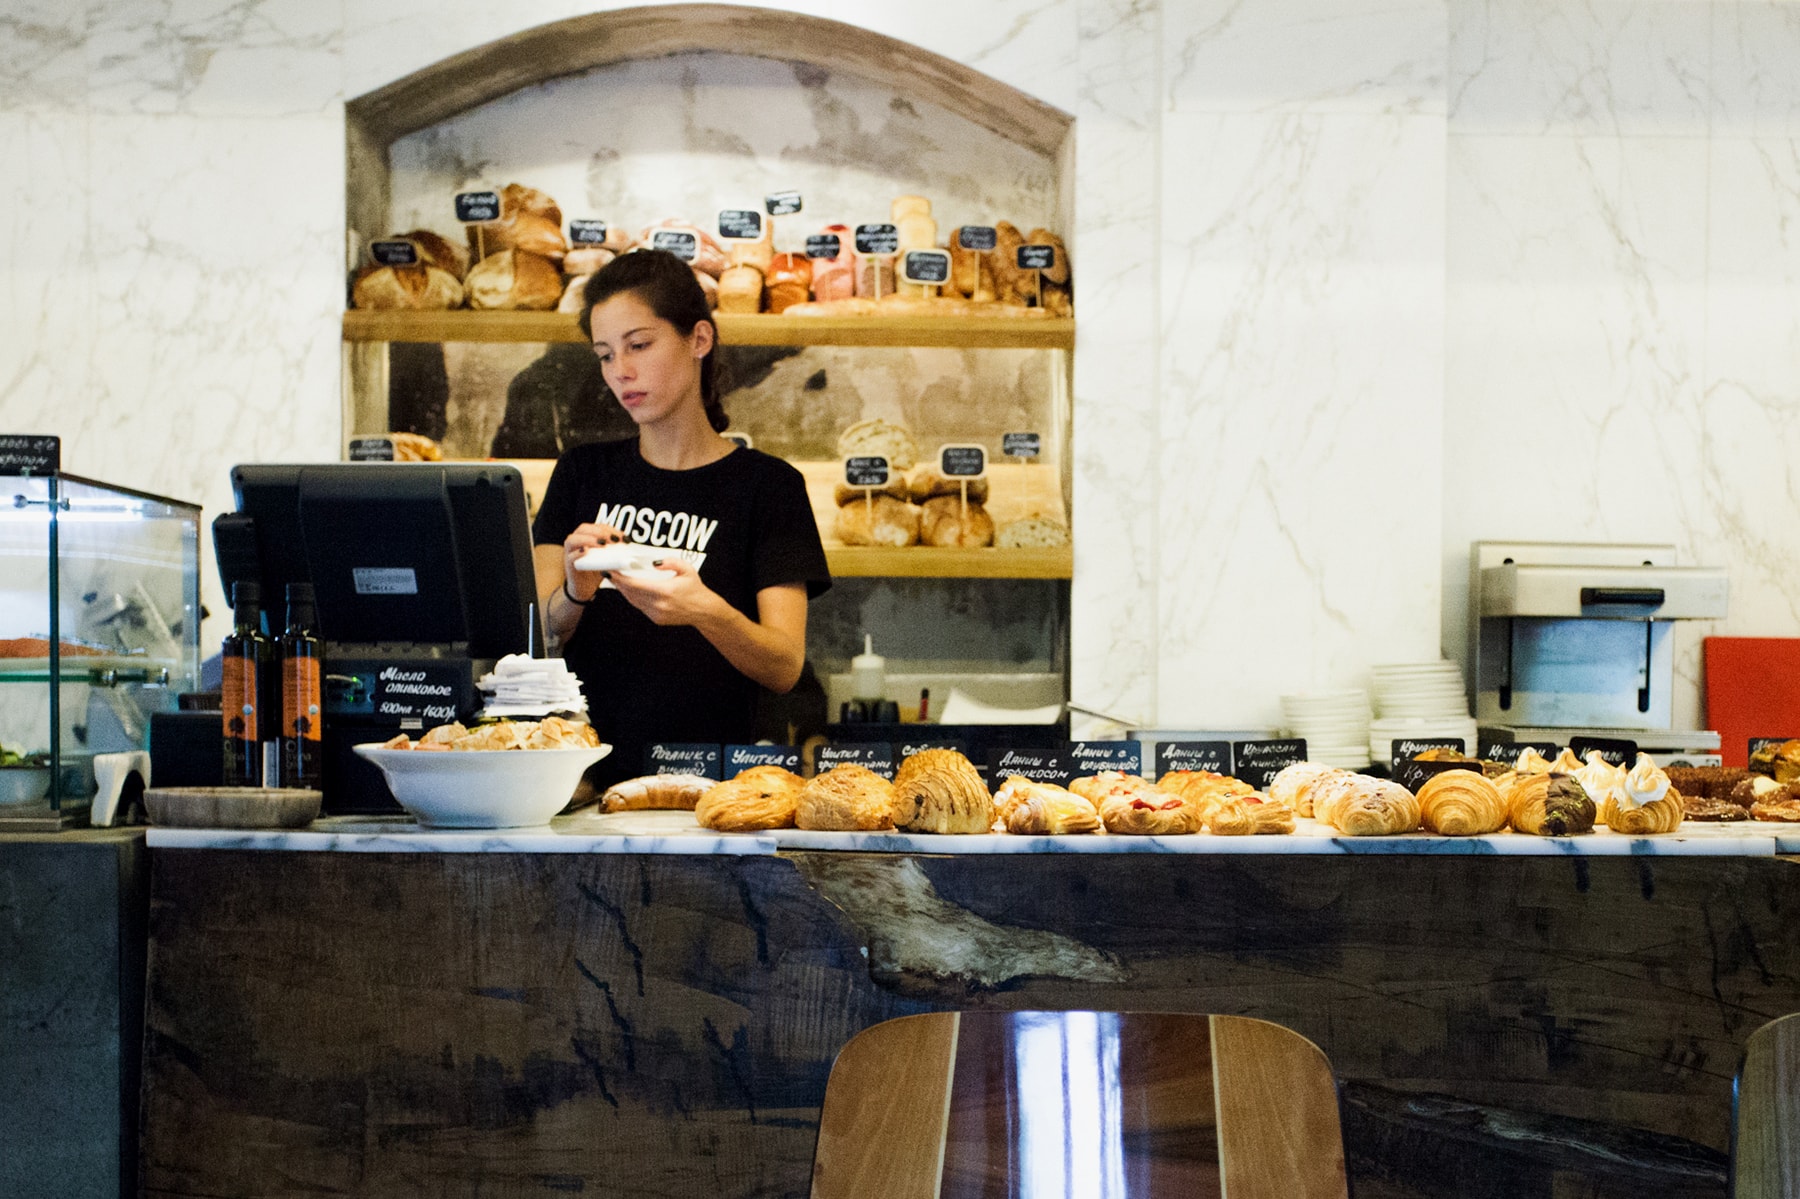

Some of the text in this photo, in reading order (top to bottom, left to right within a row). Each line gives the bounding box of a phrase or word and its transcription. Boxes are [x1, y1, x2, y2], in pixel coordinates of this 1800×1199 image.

[595, 502, 718, 552] MOSCOW
[380, 666, 426, 681] Масло
[385, 683, 452, 696] оливковое
[651, 744, 704, 761] Рогалик
[731, 749, 783, 765] Улитка
[821, 747, 860, 759] Улитка
[1072, 742, 1113, 758] Даниш
[1162, 743, 1205, 759] Даниш
[999, 750, 1043, 767] Даниш
